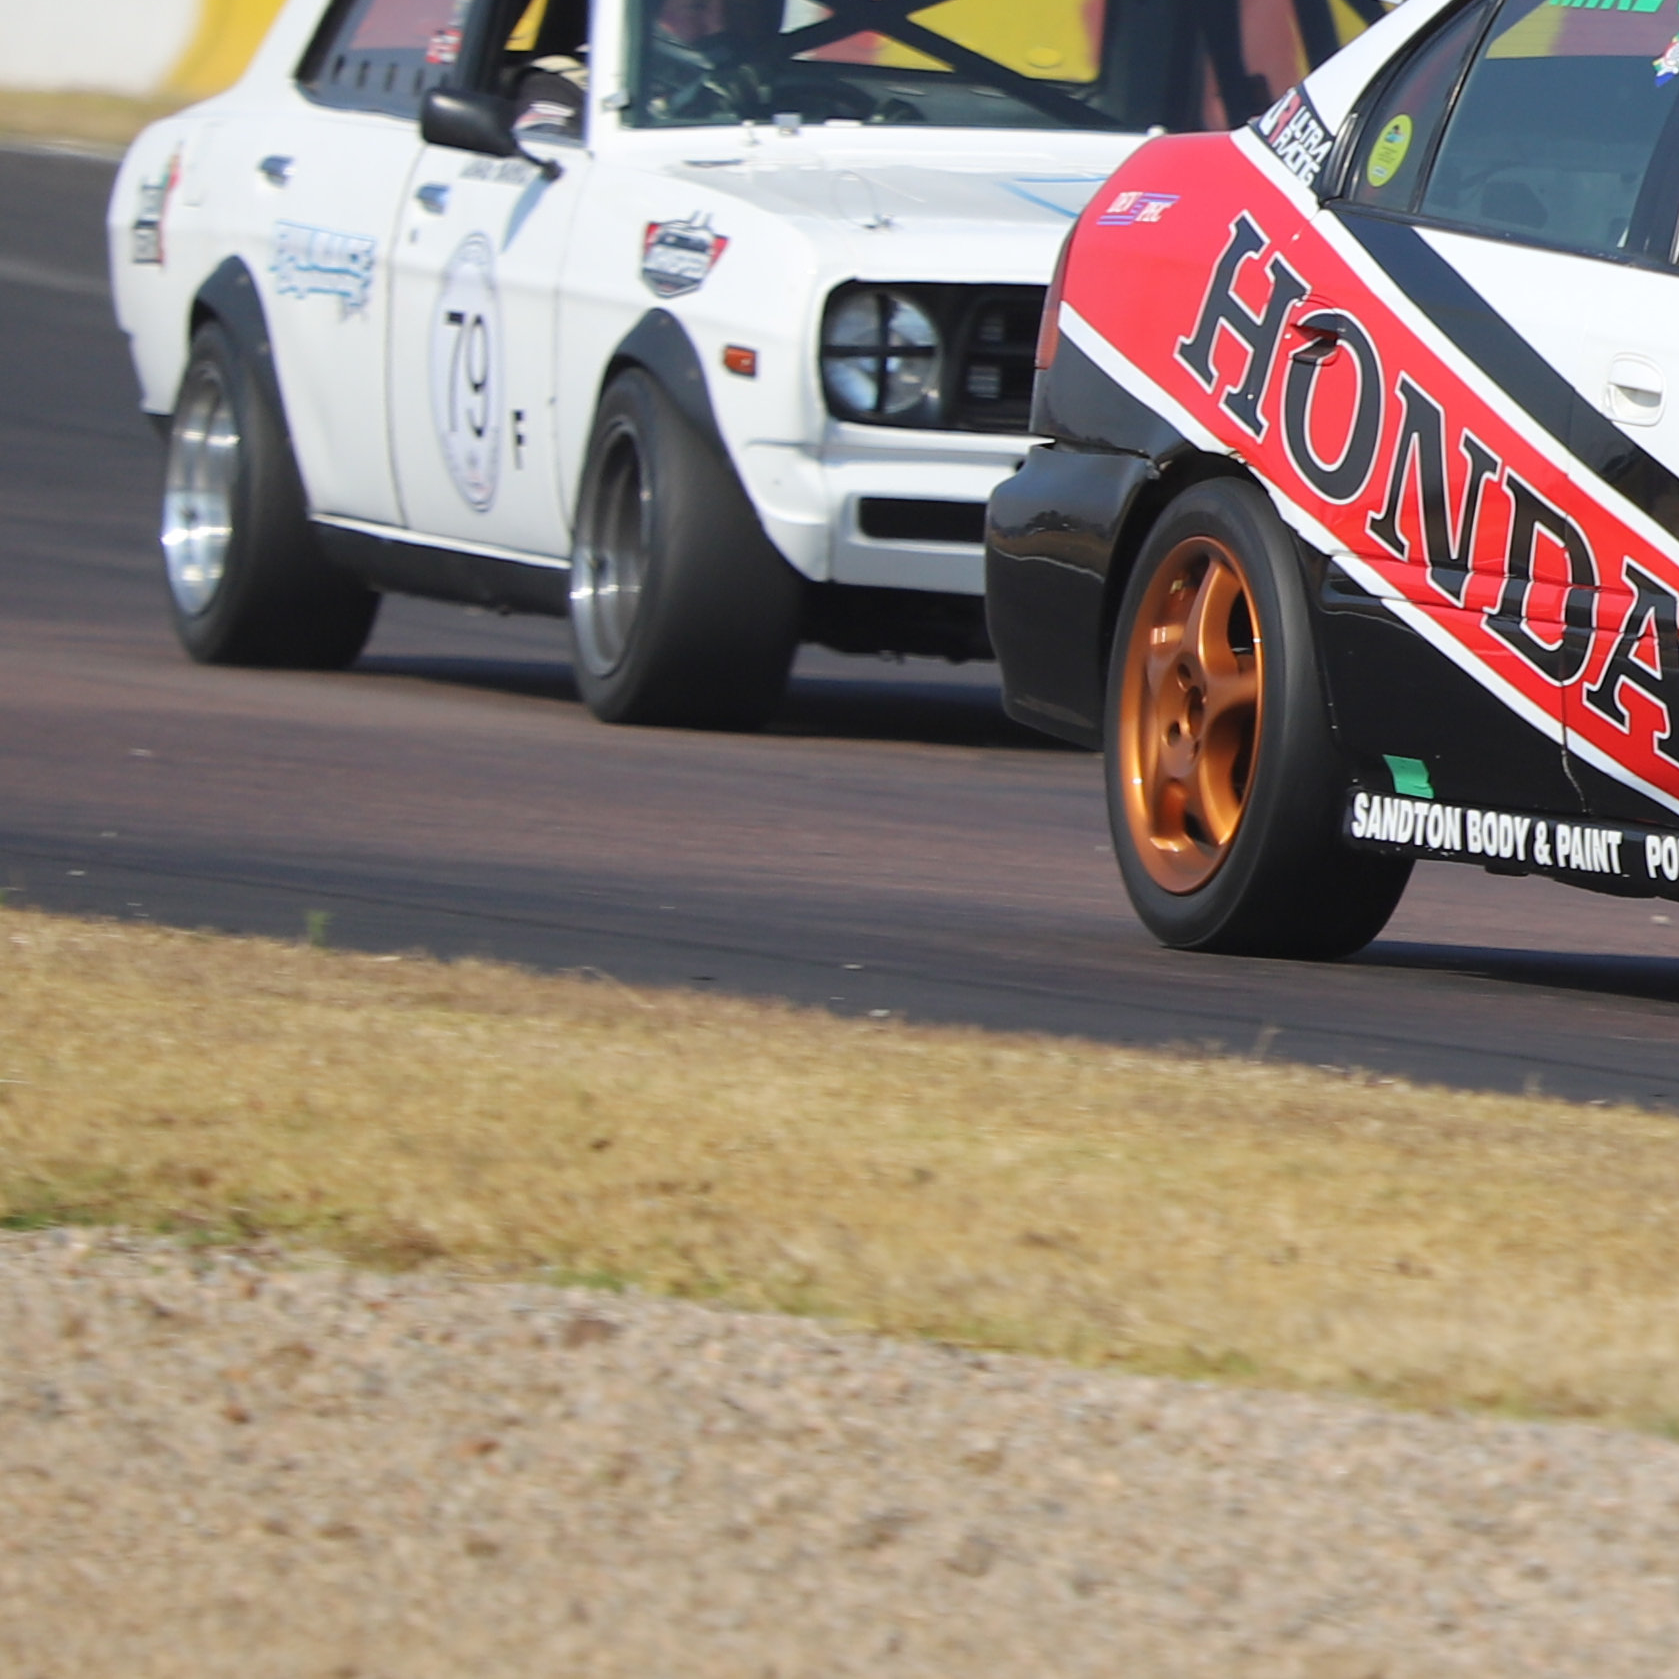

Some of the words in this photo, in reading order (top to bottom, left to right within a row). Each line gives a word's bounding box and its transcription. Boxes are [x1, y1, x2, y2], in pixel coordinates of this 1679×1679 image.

[1288, 105, 1333, 163] ULTRA
[446, 311, 490, 438] 79
[512, 409, 525, 470] F
[1351, 791, 1462, 852] SANDTON
[1465, 809, 1532, 862] BODY
[1534, 821, 1553, 866] &
[1555, 823, 1624, 875] PAINT
